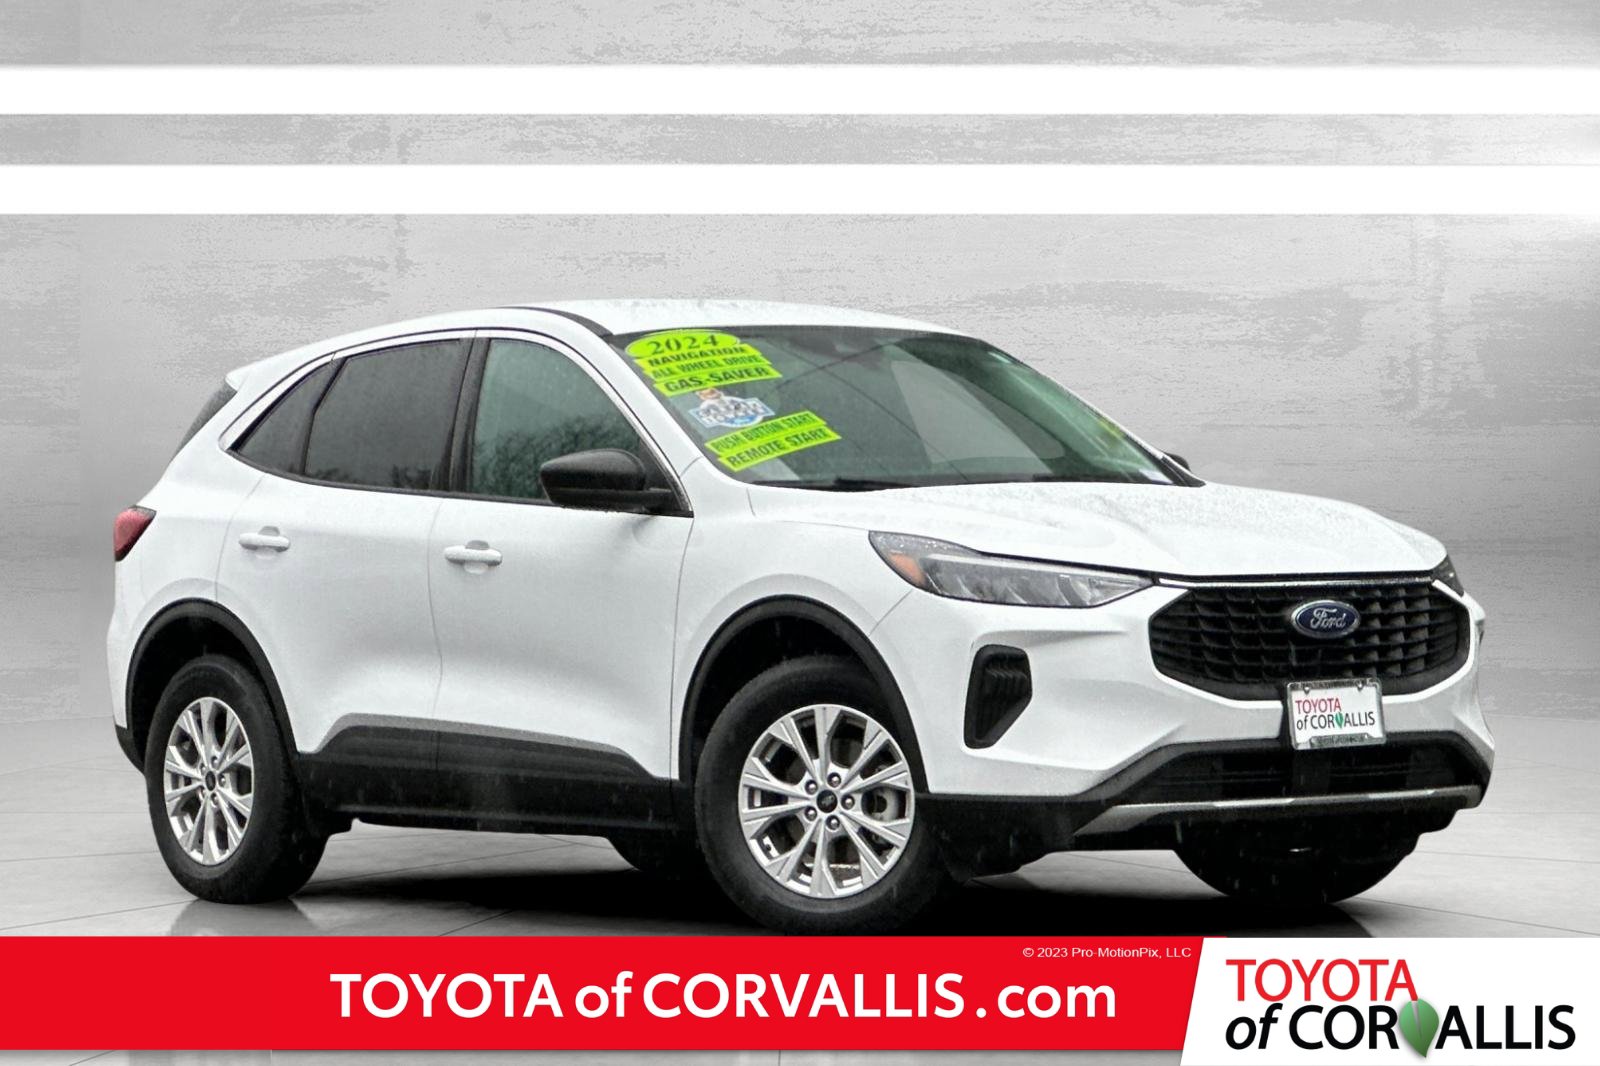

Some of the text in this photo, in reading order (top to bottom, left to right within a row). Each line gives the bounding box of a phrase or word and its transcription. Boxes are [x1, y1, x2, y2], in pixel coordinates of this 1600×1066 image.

[647, 333, 720, 355] 2024
[647, 347, 747, 366] NAVIGATION
[651, 355, 761, 379] ALL WHEEL DRIVE
[710, 434, 742, 451] PUSH
[741, 421, 785, 441] BUTTON
[781, 413, 817, 430] START
[726, 428, 831, 466] REMOTE START
[1310, 607, 1347, 629] Ford
[1295, 698, 1342, 714] TOYOTA
[1296, 714, 1309, 730] of
